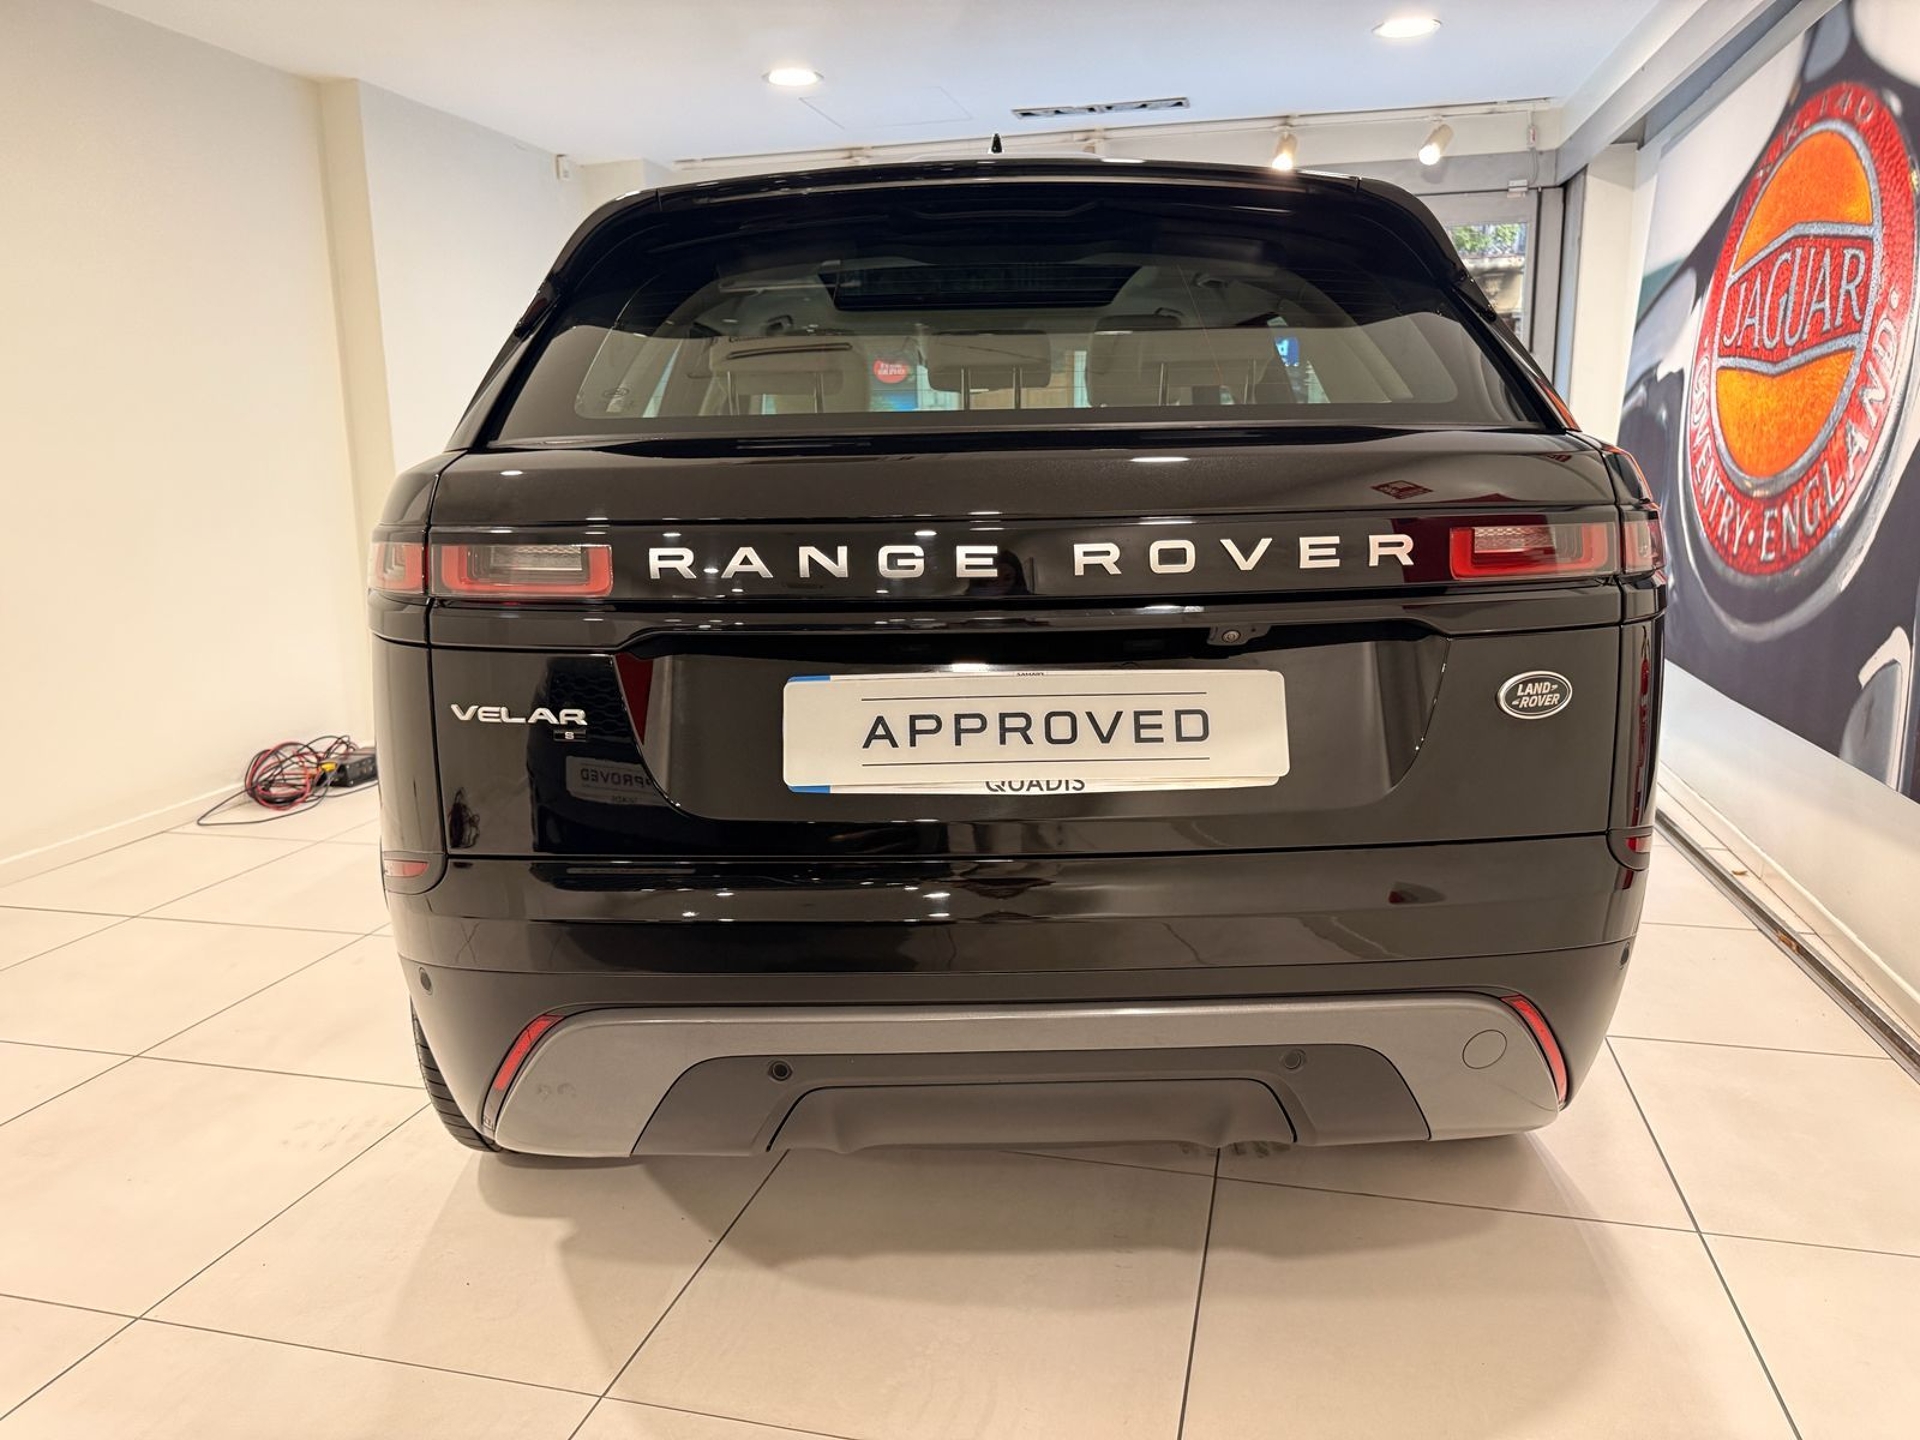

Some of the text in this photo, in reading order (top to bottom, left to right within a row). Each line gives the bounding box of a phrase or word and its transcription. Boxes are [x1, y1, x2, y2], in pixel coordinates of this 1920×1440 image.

[1722, 246, 1865, 350] JAGUAR
[1691, 317, 1898, 562] COVENTRY ENGLAND
[648, 533, 1415, 579] RANGE ROVER
[1517, 682, 1551, 696] LAND
[1519, 694, 1560, 708] ROVER
[450, 704, 588, 725] VELAR
[862, 709, 1210, 748] APPROVED
